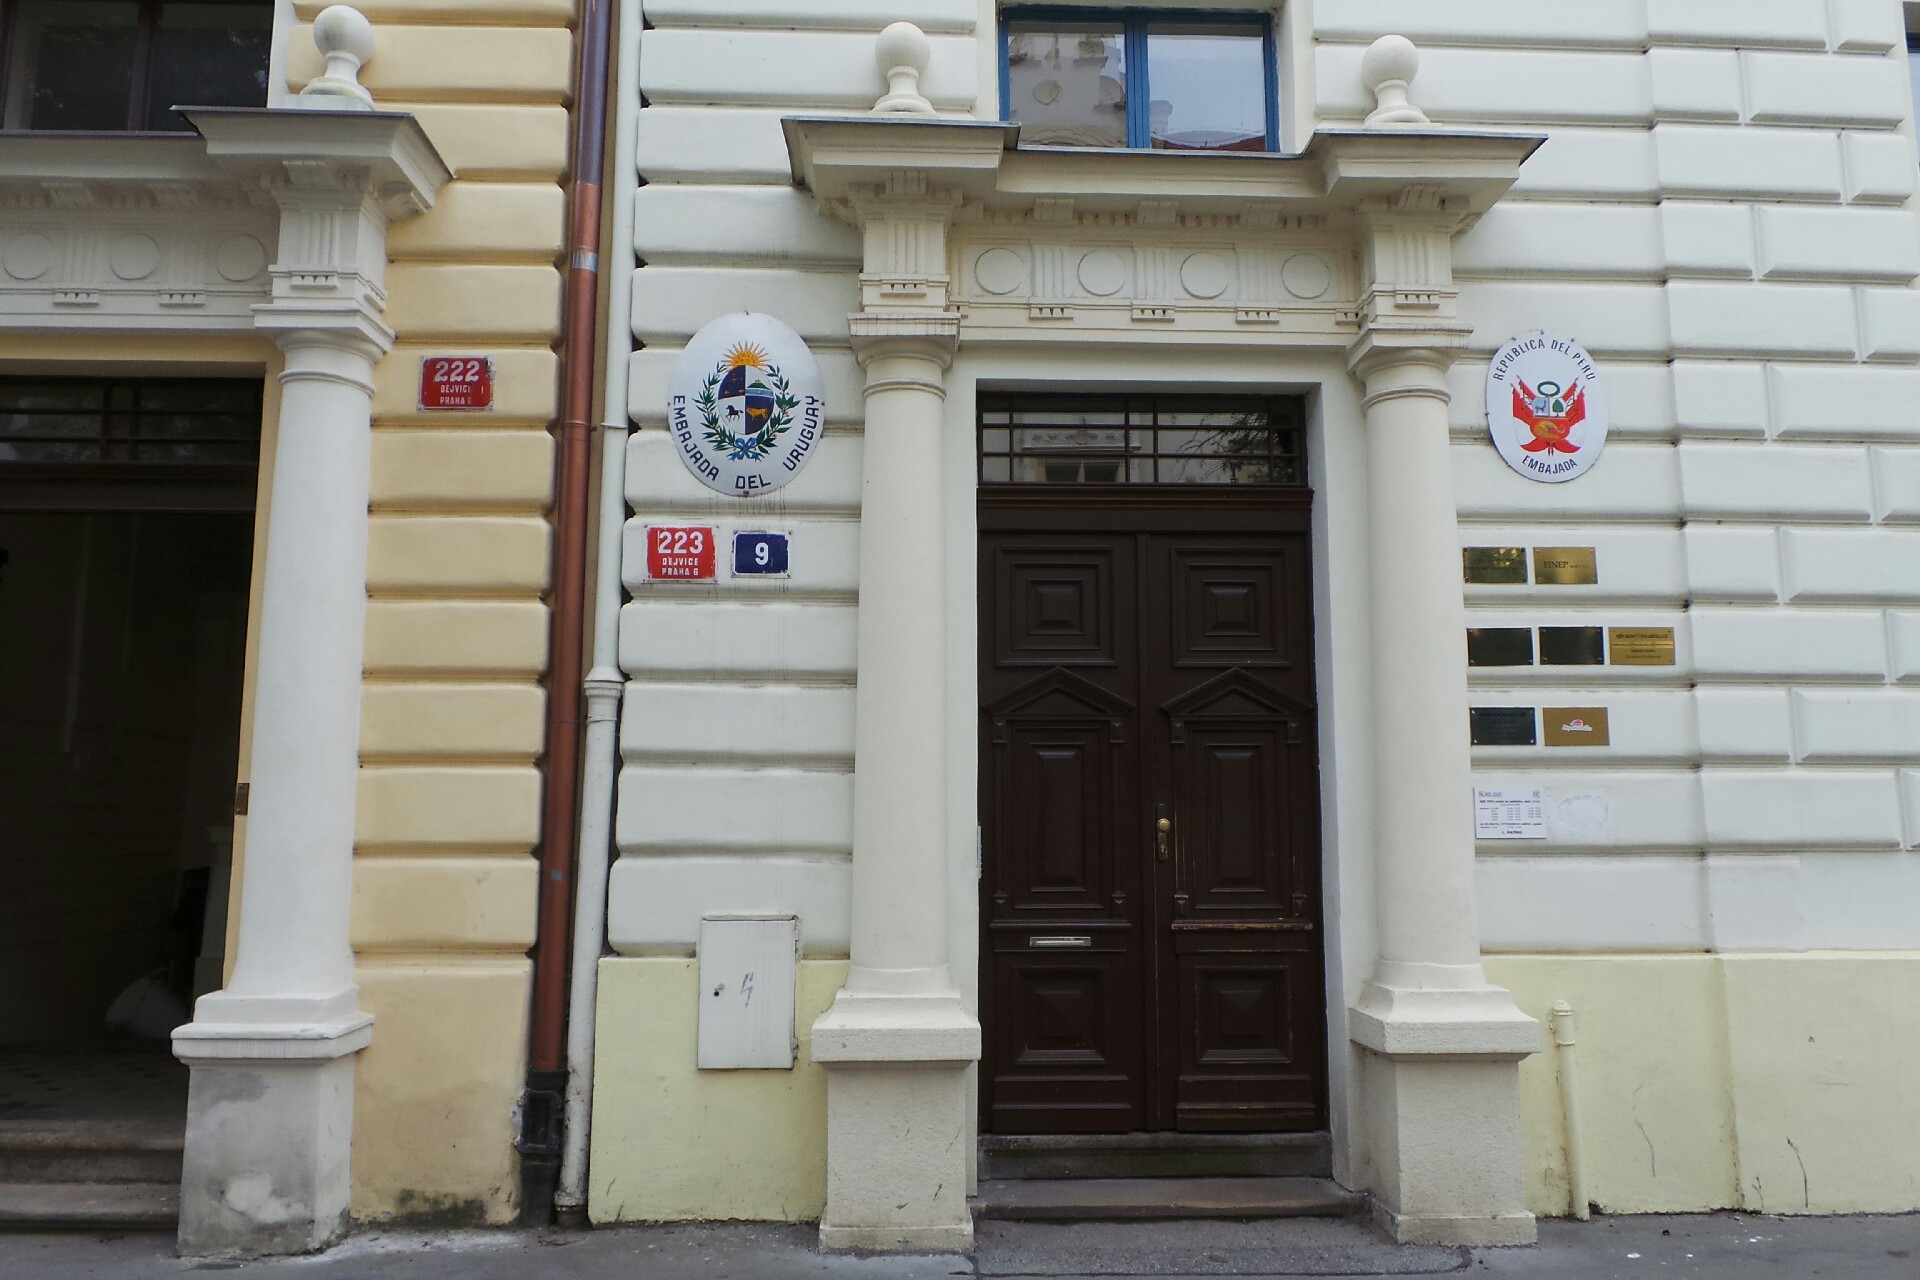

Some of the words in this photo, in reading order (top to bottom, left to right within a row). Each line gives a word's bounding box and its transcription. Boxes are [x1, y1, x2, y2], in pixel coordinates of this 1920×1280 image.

[1493, 338, 1546, 381] REPUBLICA
[1550, 339, 1570, 356] DEL
[1572, 352, 1597, 381] PERU
[434, 360, 480, 382] 222
[439, 396, 465, 405] PRAHA
[673, 395, 720, 481] EMBAJADA
[734, 474, 772, 489] DEL
[782, 395, 819, 471] URUGUAY
[1521, 454, 1578, 475] EMBAJADA
[658, 531, 703, 554] 223
[662, 557, 699, 566] DEJVICE
[754, 542, 769, 566] 9
[661, 567, 690, 576] PRAHA
[693, 568, 699, 576] 6
[1543, 561, 1569, 569] FINEP
